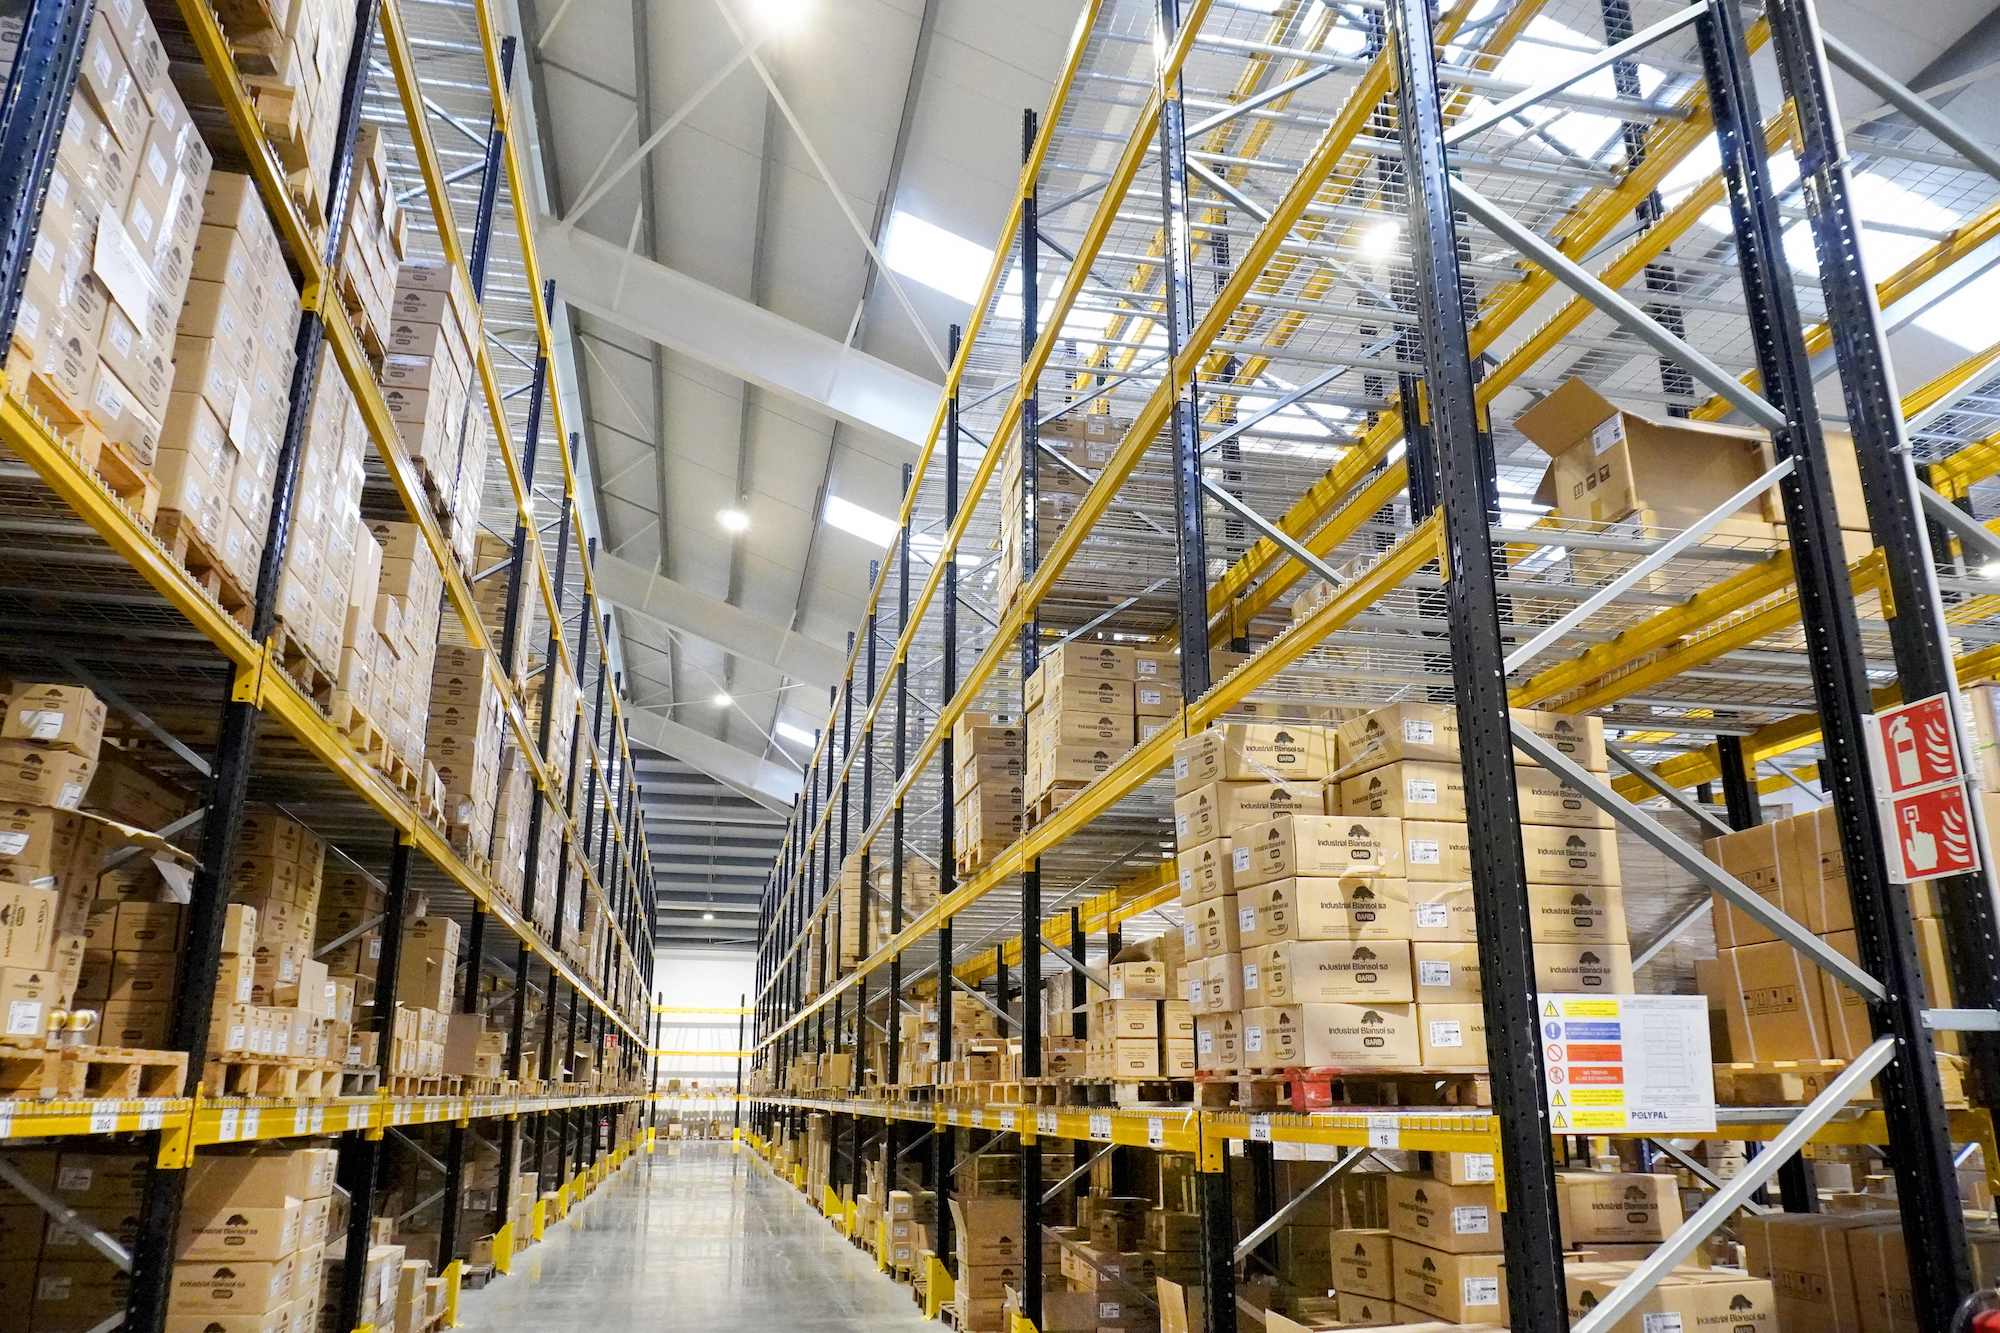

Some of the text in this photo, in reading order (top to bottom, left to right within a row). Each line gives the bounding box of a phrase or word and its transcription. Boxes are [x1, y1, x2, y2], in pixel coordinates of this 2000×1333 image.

[1352, 901, 1376, 909] Blansol
[1352, 962, 1378, 970] Blansol
[1631, 1111, 1668, 1119] POLYPAL
